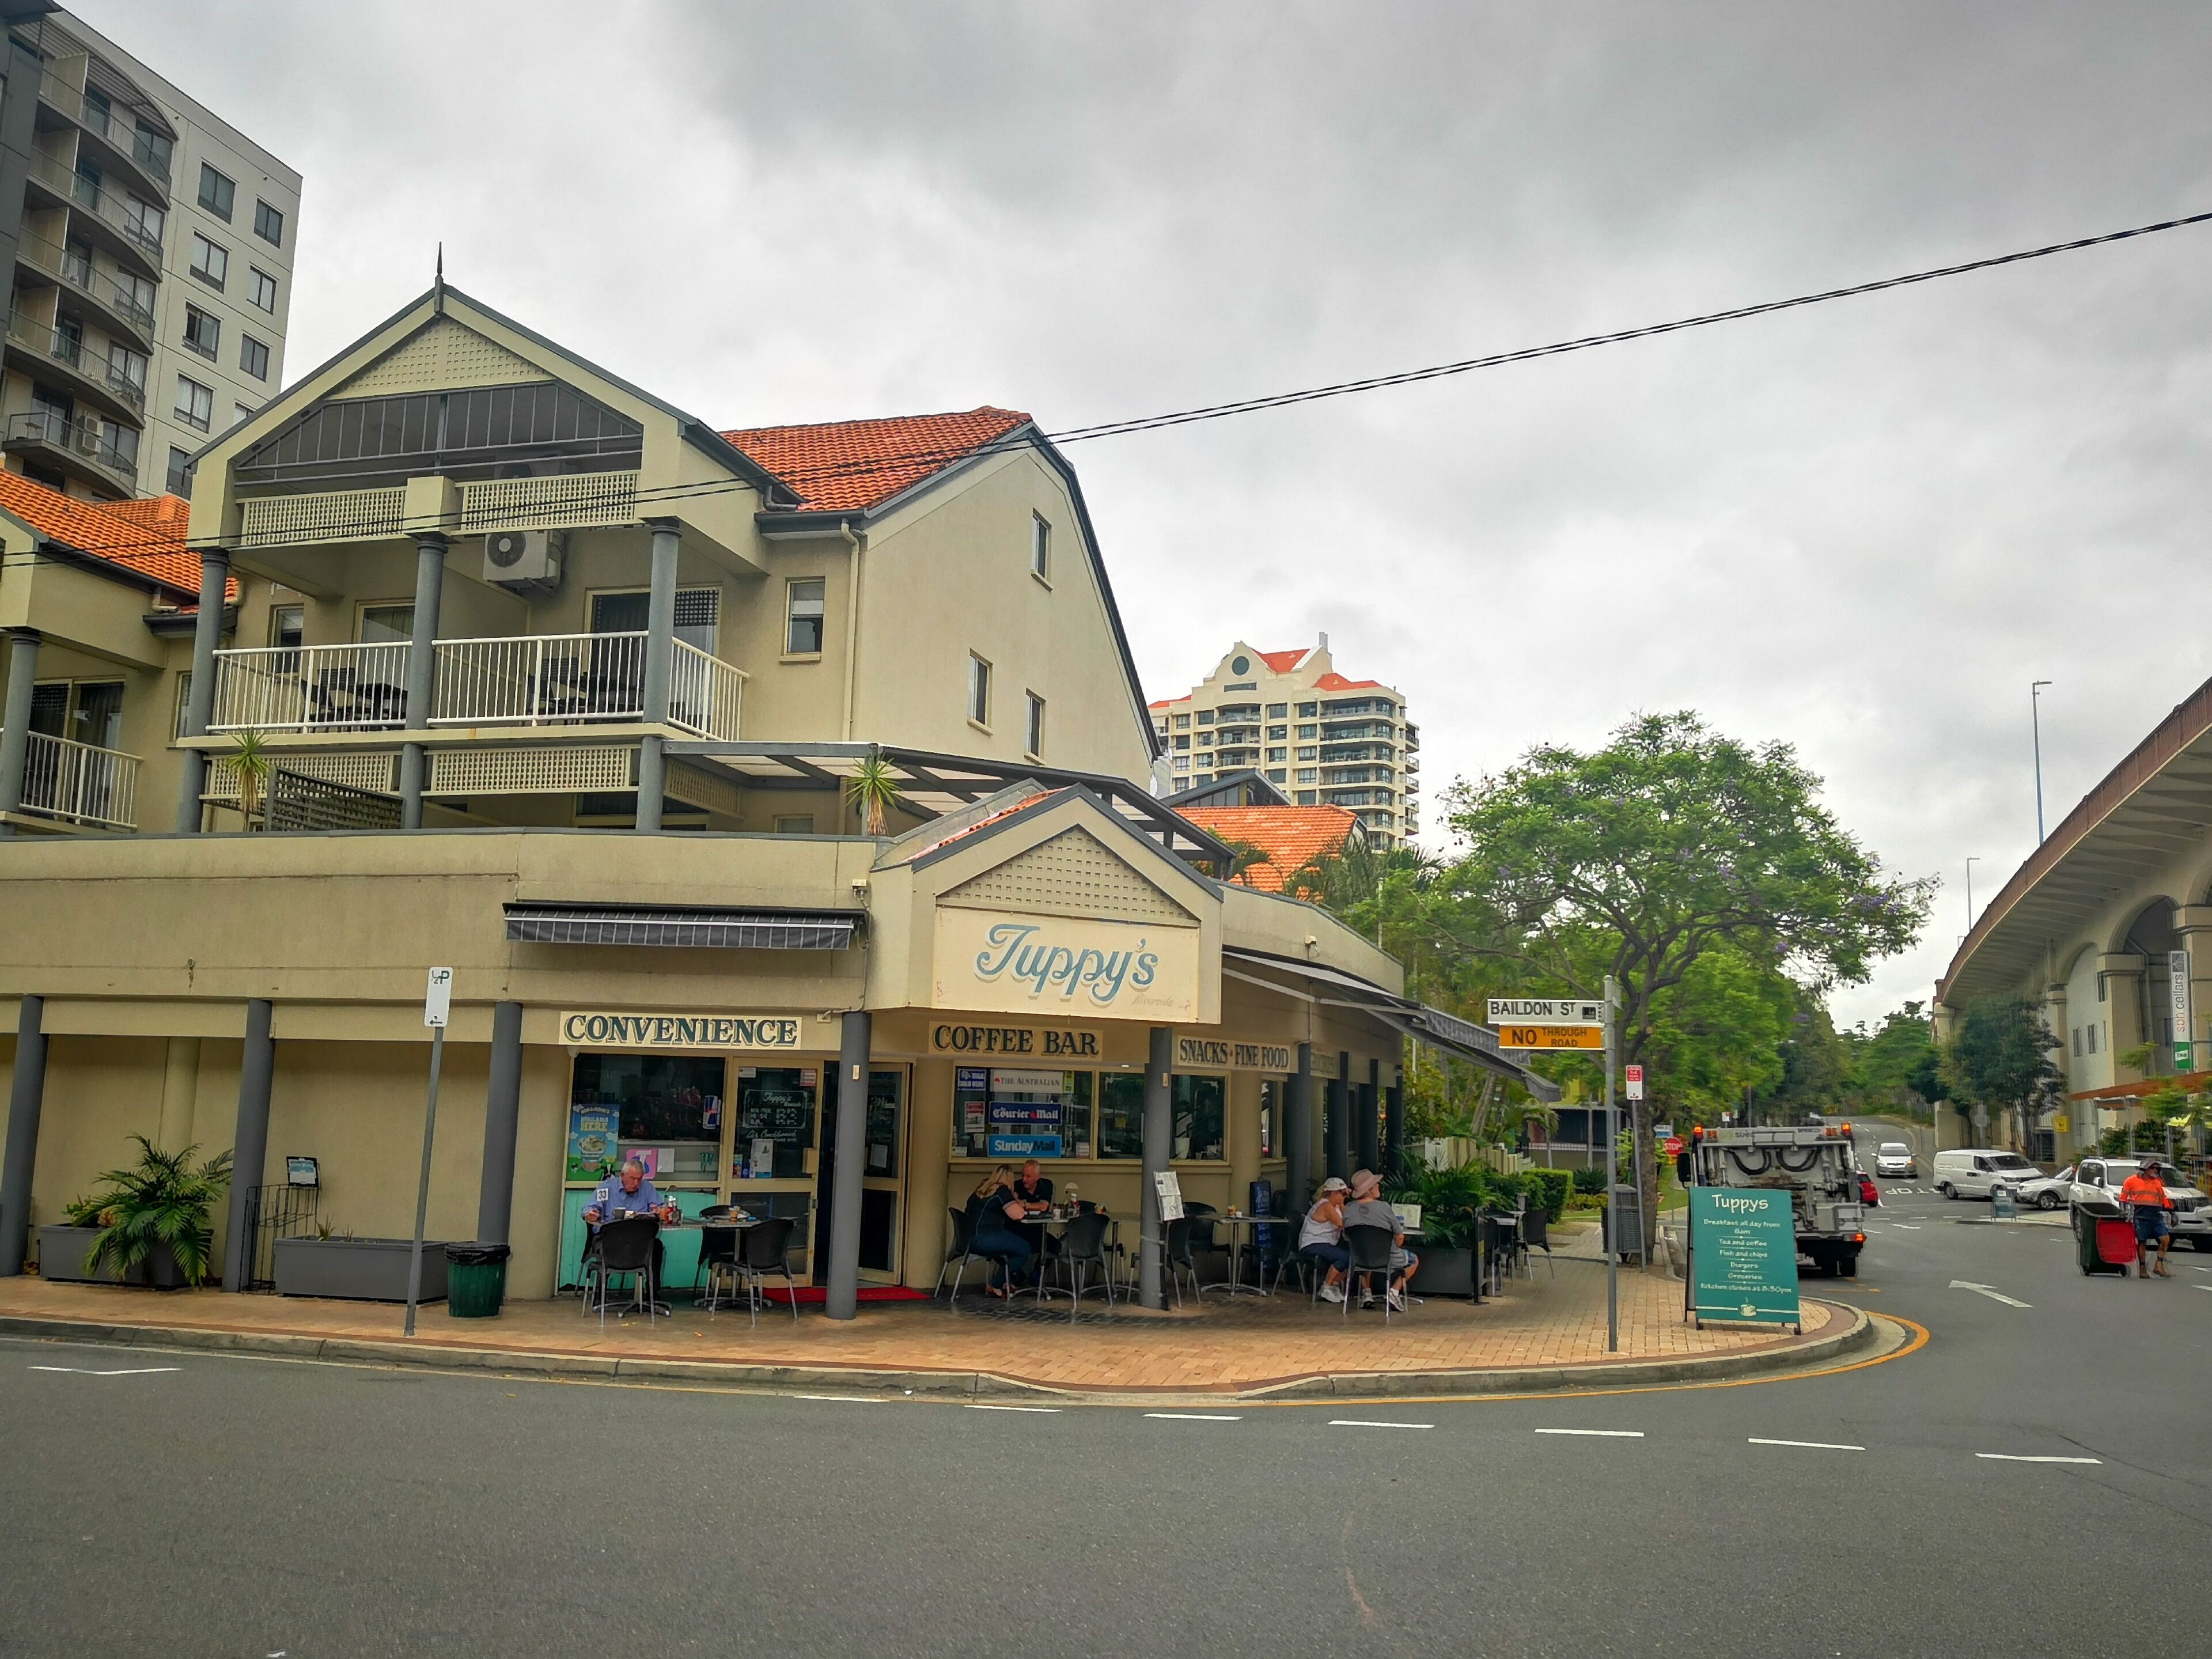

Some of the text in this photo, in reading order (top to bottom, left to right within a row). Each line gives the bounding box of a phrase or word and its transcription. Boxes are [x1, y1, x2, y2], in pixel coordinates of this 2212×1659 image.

[975, 923, 1158, 1005] Tuppy's
[2173, 974, 2184, 1009] cellars
[1490, 1002, 1576, 1016] BAILDON ST
[564, 1014, 797, 1048] CONVENIENCE
[1512, 1028, 1587, 1045] NO THROUGH
[933, 1025, 1099, 1057] COFFEE BAR
[1551, 1039, 1578, 1047] ROAD
[1179, 1039, 1228, 1065] SNACKS
[1234, 1044, 1259, 1067] FINE
[1261, 1046, 1290, 1070] FOOD
[1001, 1077, 1060, 1086] THE AUSTRALIAN
[1036, 1109, 1058, 1119] Mail
[1711, 1194, 1768, 1214] Tuppys
[1749, 1251, 1768, 1259] chips
